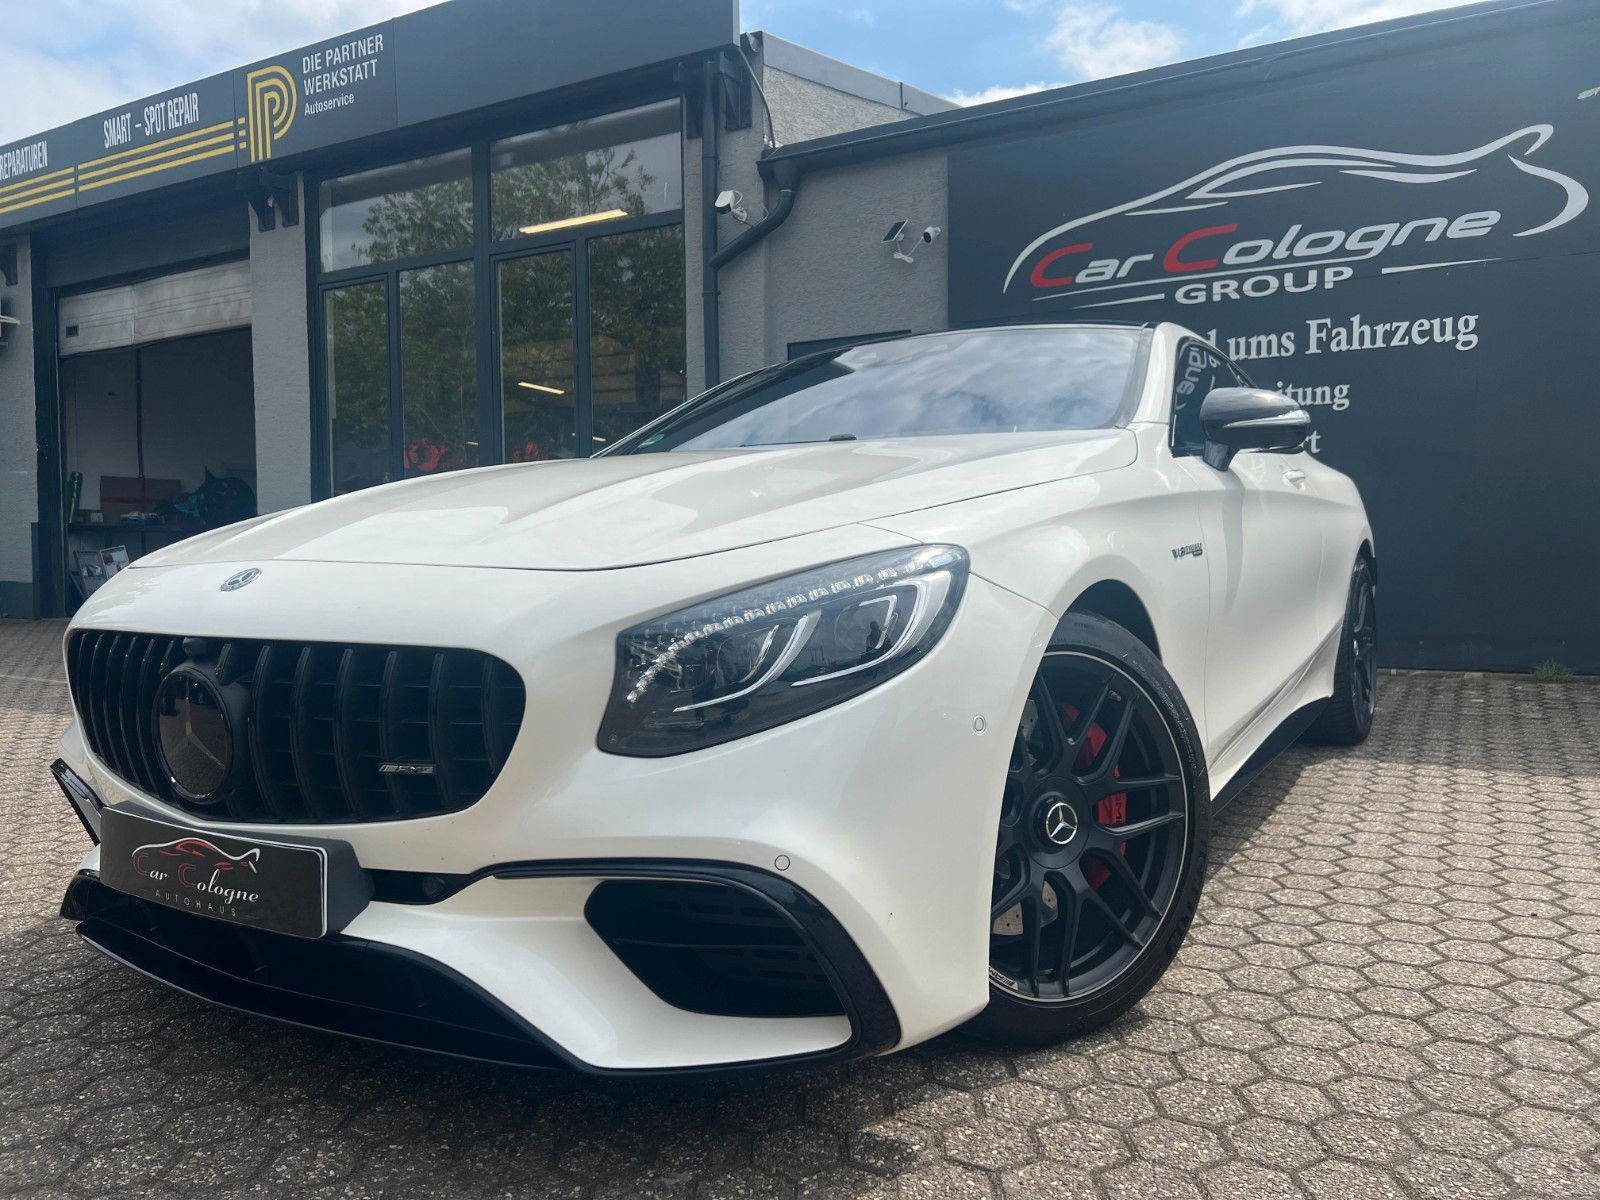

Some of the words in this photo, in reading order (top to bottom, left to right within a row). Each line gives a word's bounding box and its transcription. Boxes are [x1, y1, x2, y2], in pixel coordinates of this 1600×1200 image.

[302, 52, 322, 74] DIE
[325, 33, 384, 67] PARTNER
[303, 58, 378, 95] WERKSTATT
[103, 112, 131, 148] SMART
[144, 103, 167, 137] SPOT
[167, 92, 199, 130] REPAIR
[304, 93, 355, 116] Autoservice
[1030, 242, 1154, 288] Car
[1162, 210, 1502, 273] Cologne
[1174, 266, 1353, 305] GROUP
[1226, 330, 1296, 361] ums
[1305, 314, 1479, 355] Fahrzeug
[132, 851, 169, 881] Car
[178, 863, 259, 905] Cologne
[155, 889, 236, 917] AUTOHAUS
